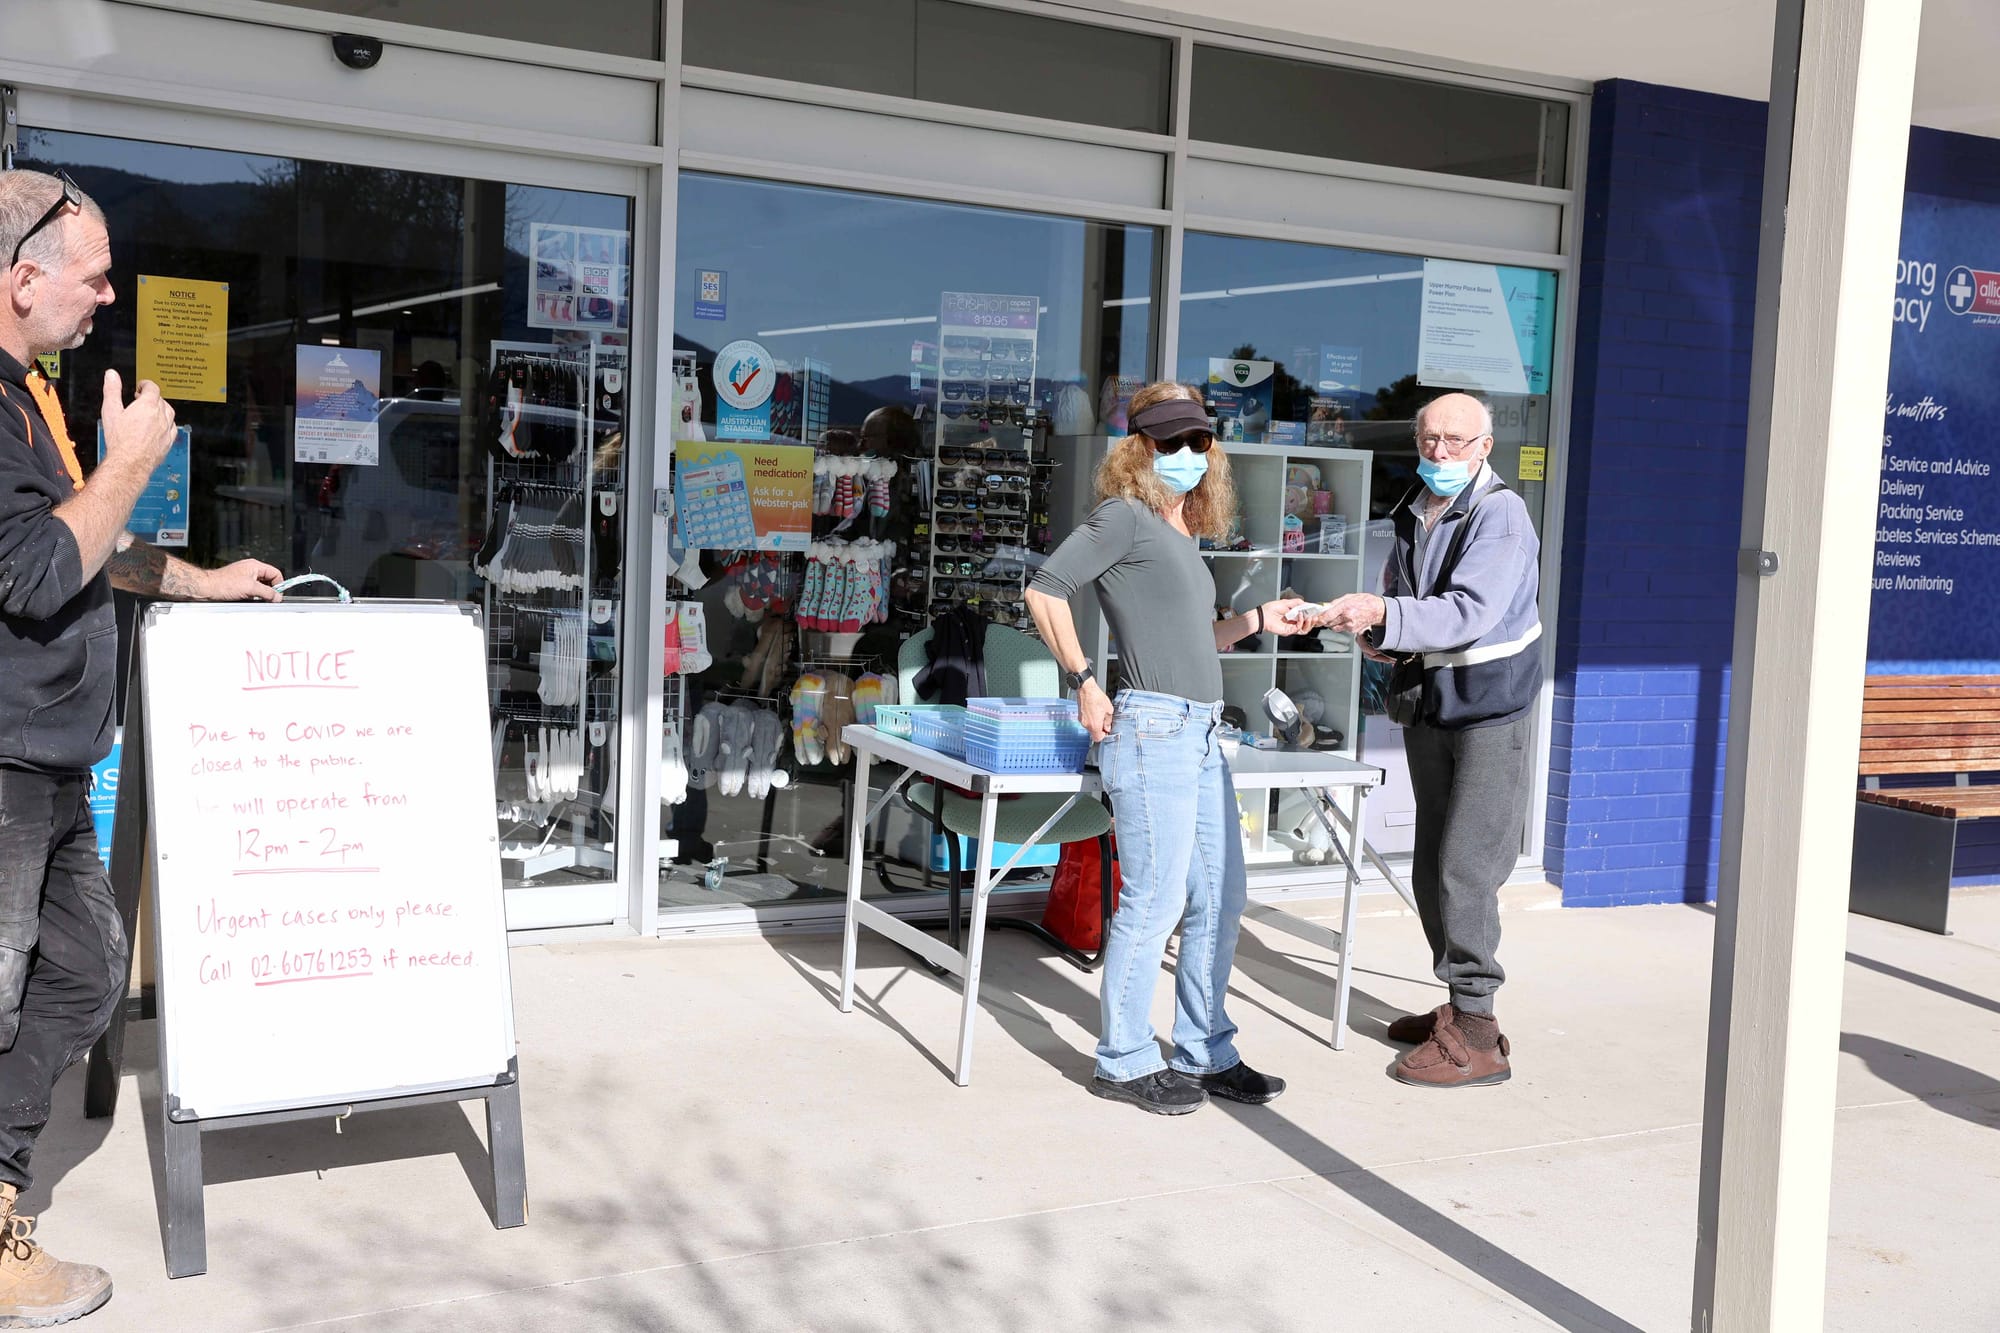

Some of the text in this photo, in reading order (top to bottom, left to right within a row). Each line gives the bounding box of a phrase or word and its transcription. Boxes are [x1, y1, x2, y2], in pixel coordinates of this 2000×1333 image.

[1896, 259, 1936, 296] ong
[169, 290, 196, 299] NOTICE
[583, 285, 608, 294] LOX
[1428, 289, 1444, 297] Power
[974, 315, 1008, 326] $19.95
[1893, 297, 1932, 333] acy
[1897, 396, 1948, 422] matters
[721, 417, 767, 426] AUSTRALIAN
[723, 425, 764, 433] STANDARD
[754, 457, 778, 466] Need
[1889, 455, 1928, 472] Service
[1930, 458, 1952, 474] and
[1954, 459, 1990, 476] Advice
[754, 468, 808, 479] medication?
[753, 487, 769, 497] Ask
[772, 487, 785, 497] for
[1880, 479, 1925, 500] Delivery
[753, 499, 809, 510] Webster-pak
[1880, 503, 1964, 524] Packing Service
[1875, 526, 1912, 543] abetes
[1914, 528, 1958, 545] Services
[1876, 550, 1921, 567] Reviews
[1871, 575, 1954, 595] sure Monitoring
[245, 650, 355, 683] NOTICE
[189, 722, 238, 748] Due
[248, 726, 266, 742] to
[356, 725, 376, 737] we
[387, 723, 413, 737] are
[191, 753, 364, 776] closed to the public.
[233, 797, 264, 816] will
[276, 791, 350, 819] operate
[362, 781, 408, 808] from
[237, 828, 290, 862] 12pm
[319, 827, 365, 864] 2pm
[197, 898, 273, 938] Urgent
[282, 907, 338, 928] cases
[348, 905, 386, 929] only
[199, 954, 232, 985] Call
[382, 949, 400, 969] if
